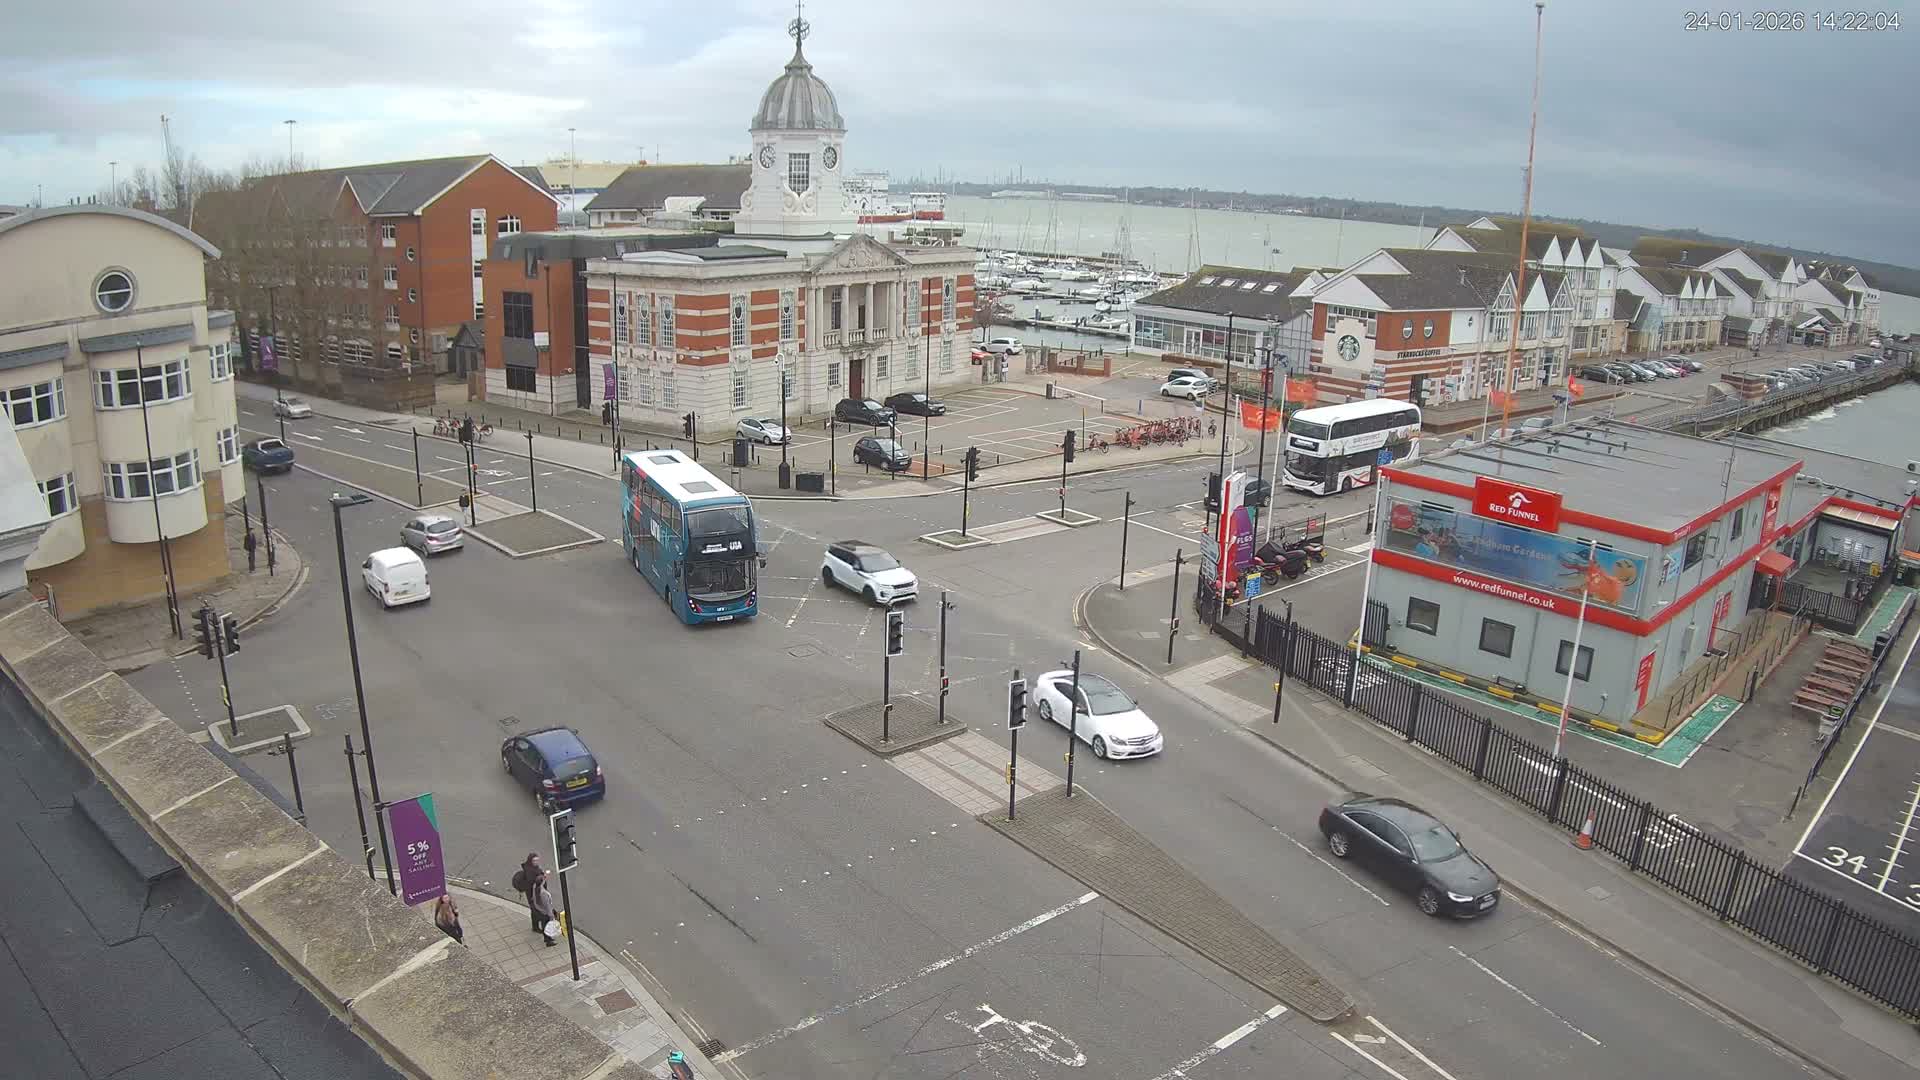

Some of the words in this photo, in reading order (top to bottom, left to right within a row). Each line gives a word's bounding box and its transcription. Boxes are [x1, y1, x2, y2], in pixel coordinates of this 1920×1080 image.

[1397, 350, 1424, 359] STARBUCKS
[1488, 502, 1506, 515] RED
[1508, 507, 1541, 522] FUNNEL
[1453, 573, 1555, 609] www.redfunnel.co.uk
[412, 852, 427, 861] OFF
[1822, 845, 1868, 875] 34
